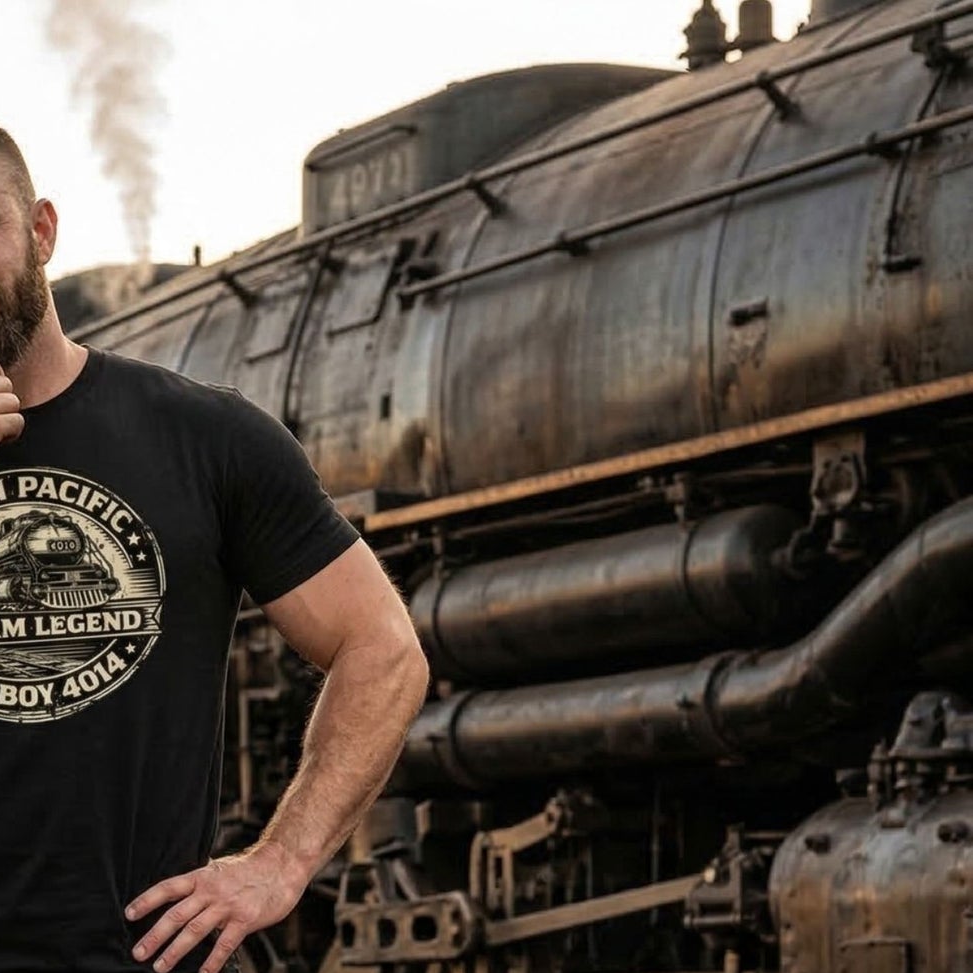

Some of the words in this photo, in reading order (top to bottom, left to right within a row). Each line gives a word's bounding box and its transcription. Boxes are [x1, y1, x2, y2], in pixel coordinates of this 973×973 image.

[18, 476, 133, 533] PACIFIC
[34, 610, 142, 636] LEGEND
[61, 651, 128, 698] 4014
